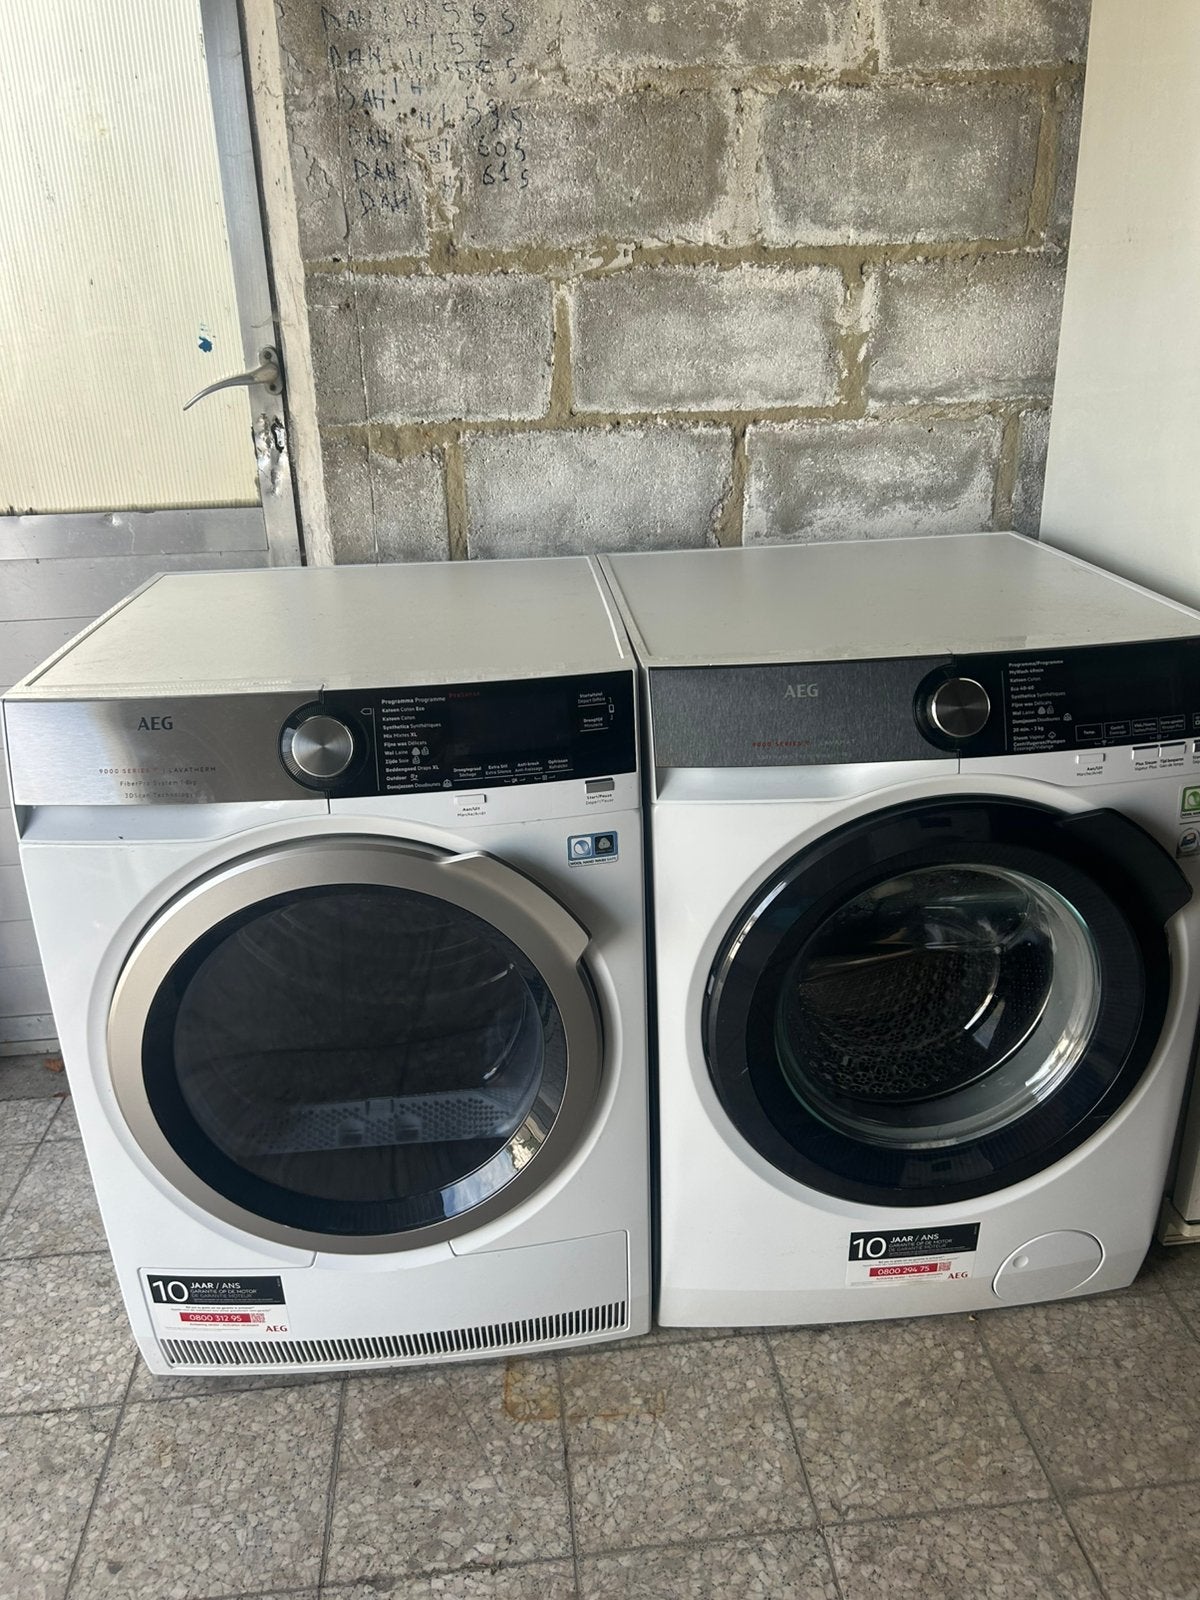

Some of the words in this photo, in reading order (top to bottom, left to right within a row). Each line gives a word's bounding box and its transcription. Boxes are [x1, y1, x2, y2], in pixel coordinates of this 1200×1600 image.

[784, 683, 819, 698] AEG
[138, 716, 174, 731] AEG
[853, 1237, 887, 1259] 10
[890, 1235, 914, 1243] JAAR
[920, 1233, 939, 1241] ANS
[877, 1267, 901, 1275] 0800
[902, 1266, 918, 1274] 294
[947, 1271, 968, 1280] AEG
[153, 1280, 189, 1302] 10
[189, 1314, 213, 1322] 0800
[215, 1314, 229, 1322] 312
[265, 1325, 288, 1333] AEG
